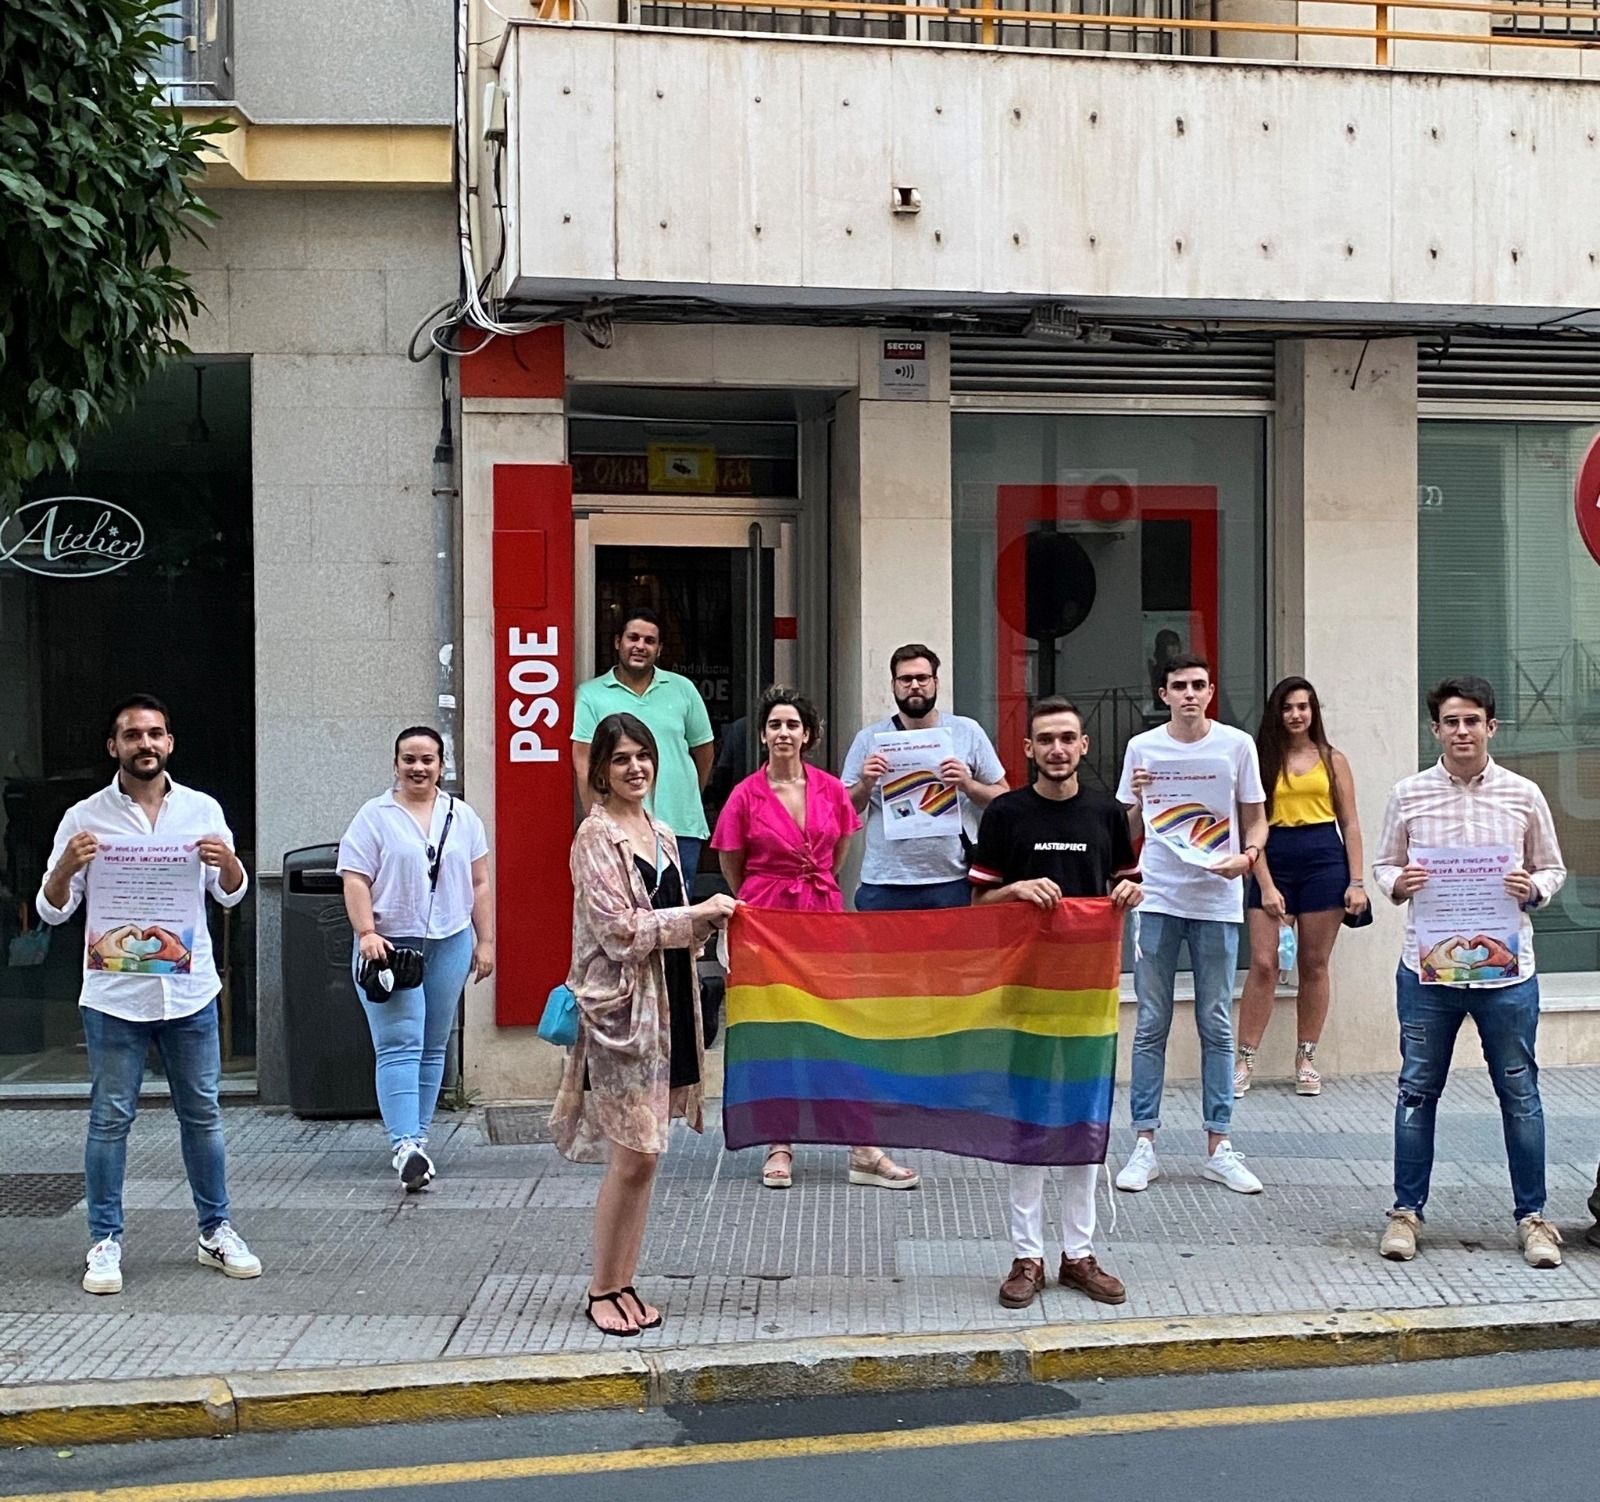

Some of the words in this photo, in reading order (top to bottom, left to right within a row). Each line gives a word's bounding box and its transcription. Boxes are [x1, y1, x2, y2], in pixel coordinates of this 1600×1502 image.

[1, 505, 141, 561] Atelier
[508, 626, 559, 762] PSOE
[1034, 842, 1087, 852] MASTERPIECE
